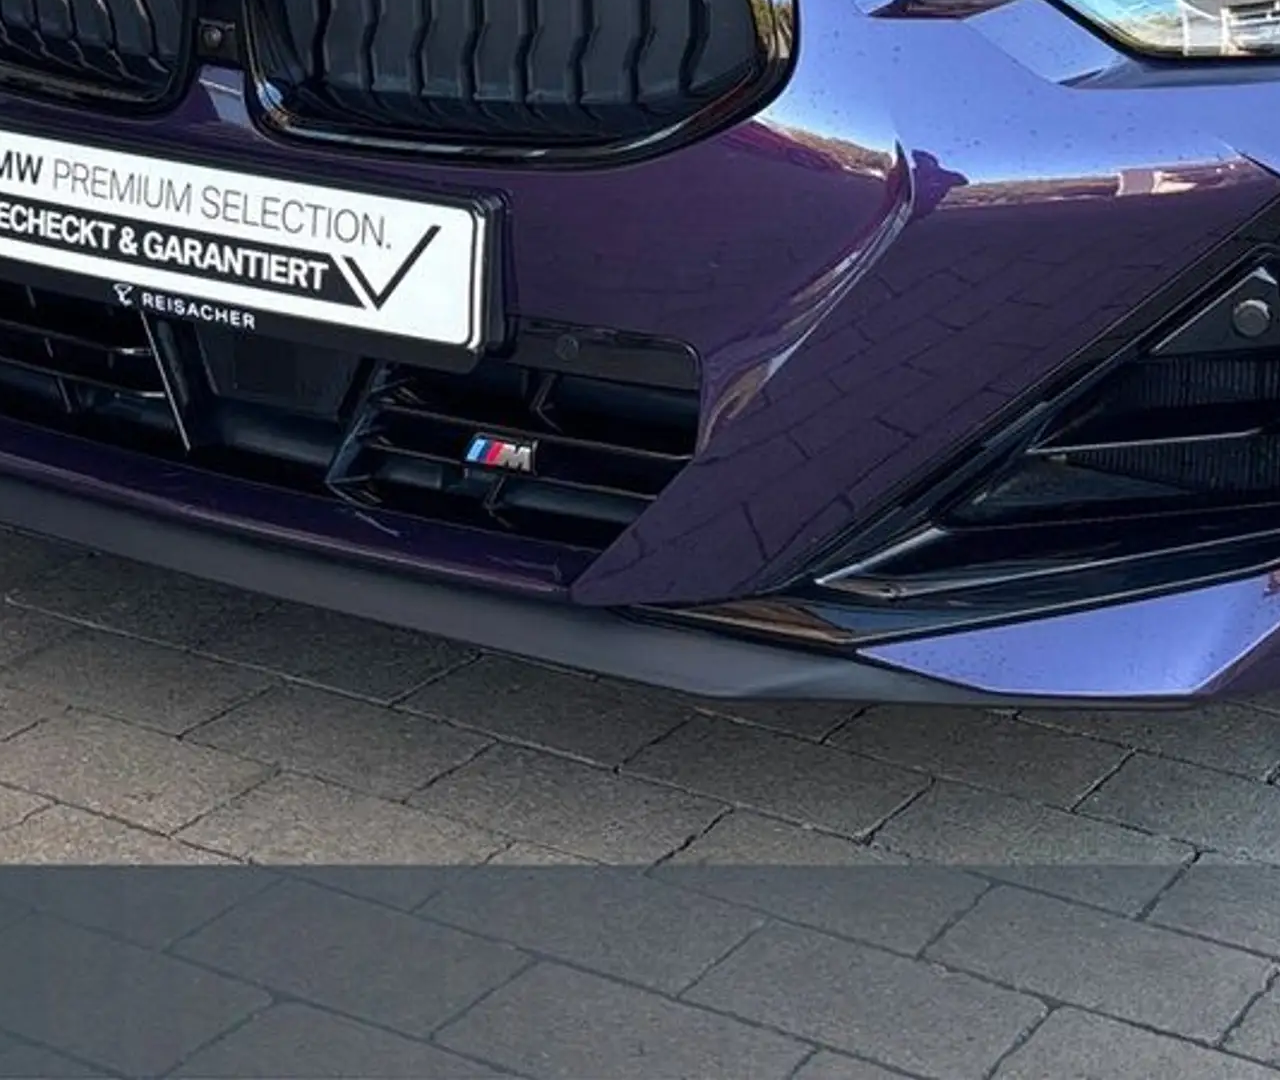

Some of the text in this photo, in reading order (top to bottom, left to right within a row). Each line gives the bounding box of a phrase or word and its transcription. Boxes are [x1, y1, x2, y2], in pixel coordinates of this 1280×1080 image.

[52, 158, 193, 215] PREMIUM
[200, 185, 392, 249] SELECTION.
[119, 226, 138, 256] &
[143, 231, 330, 291] GARANTIERT
[141, 292, 256, 330] REISACHER
